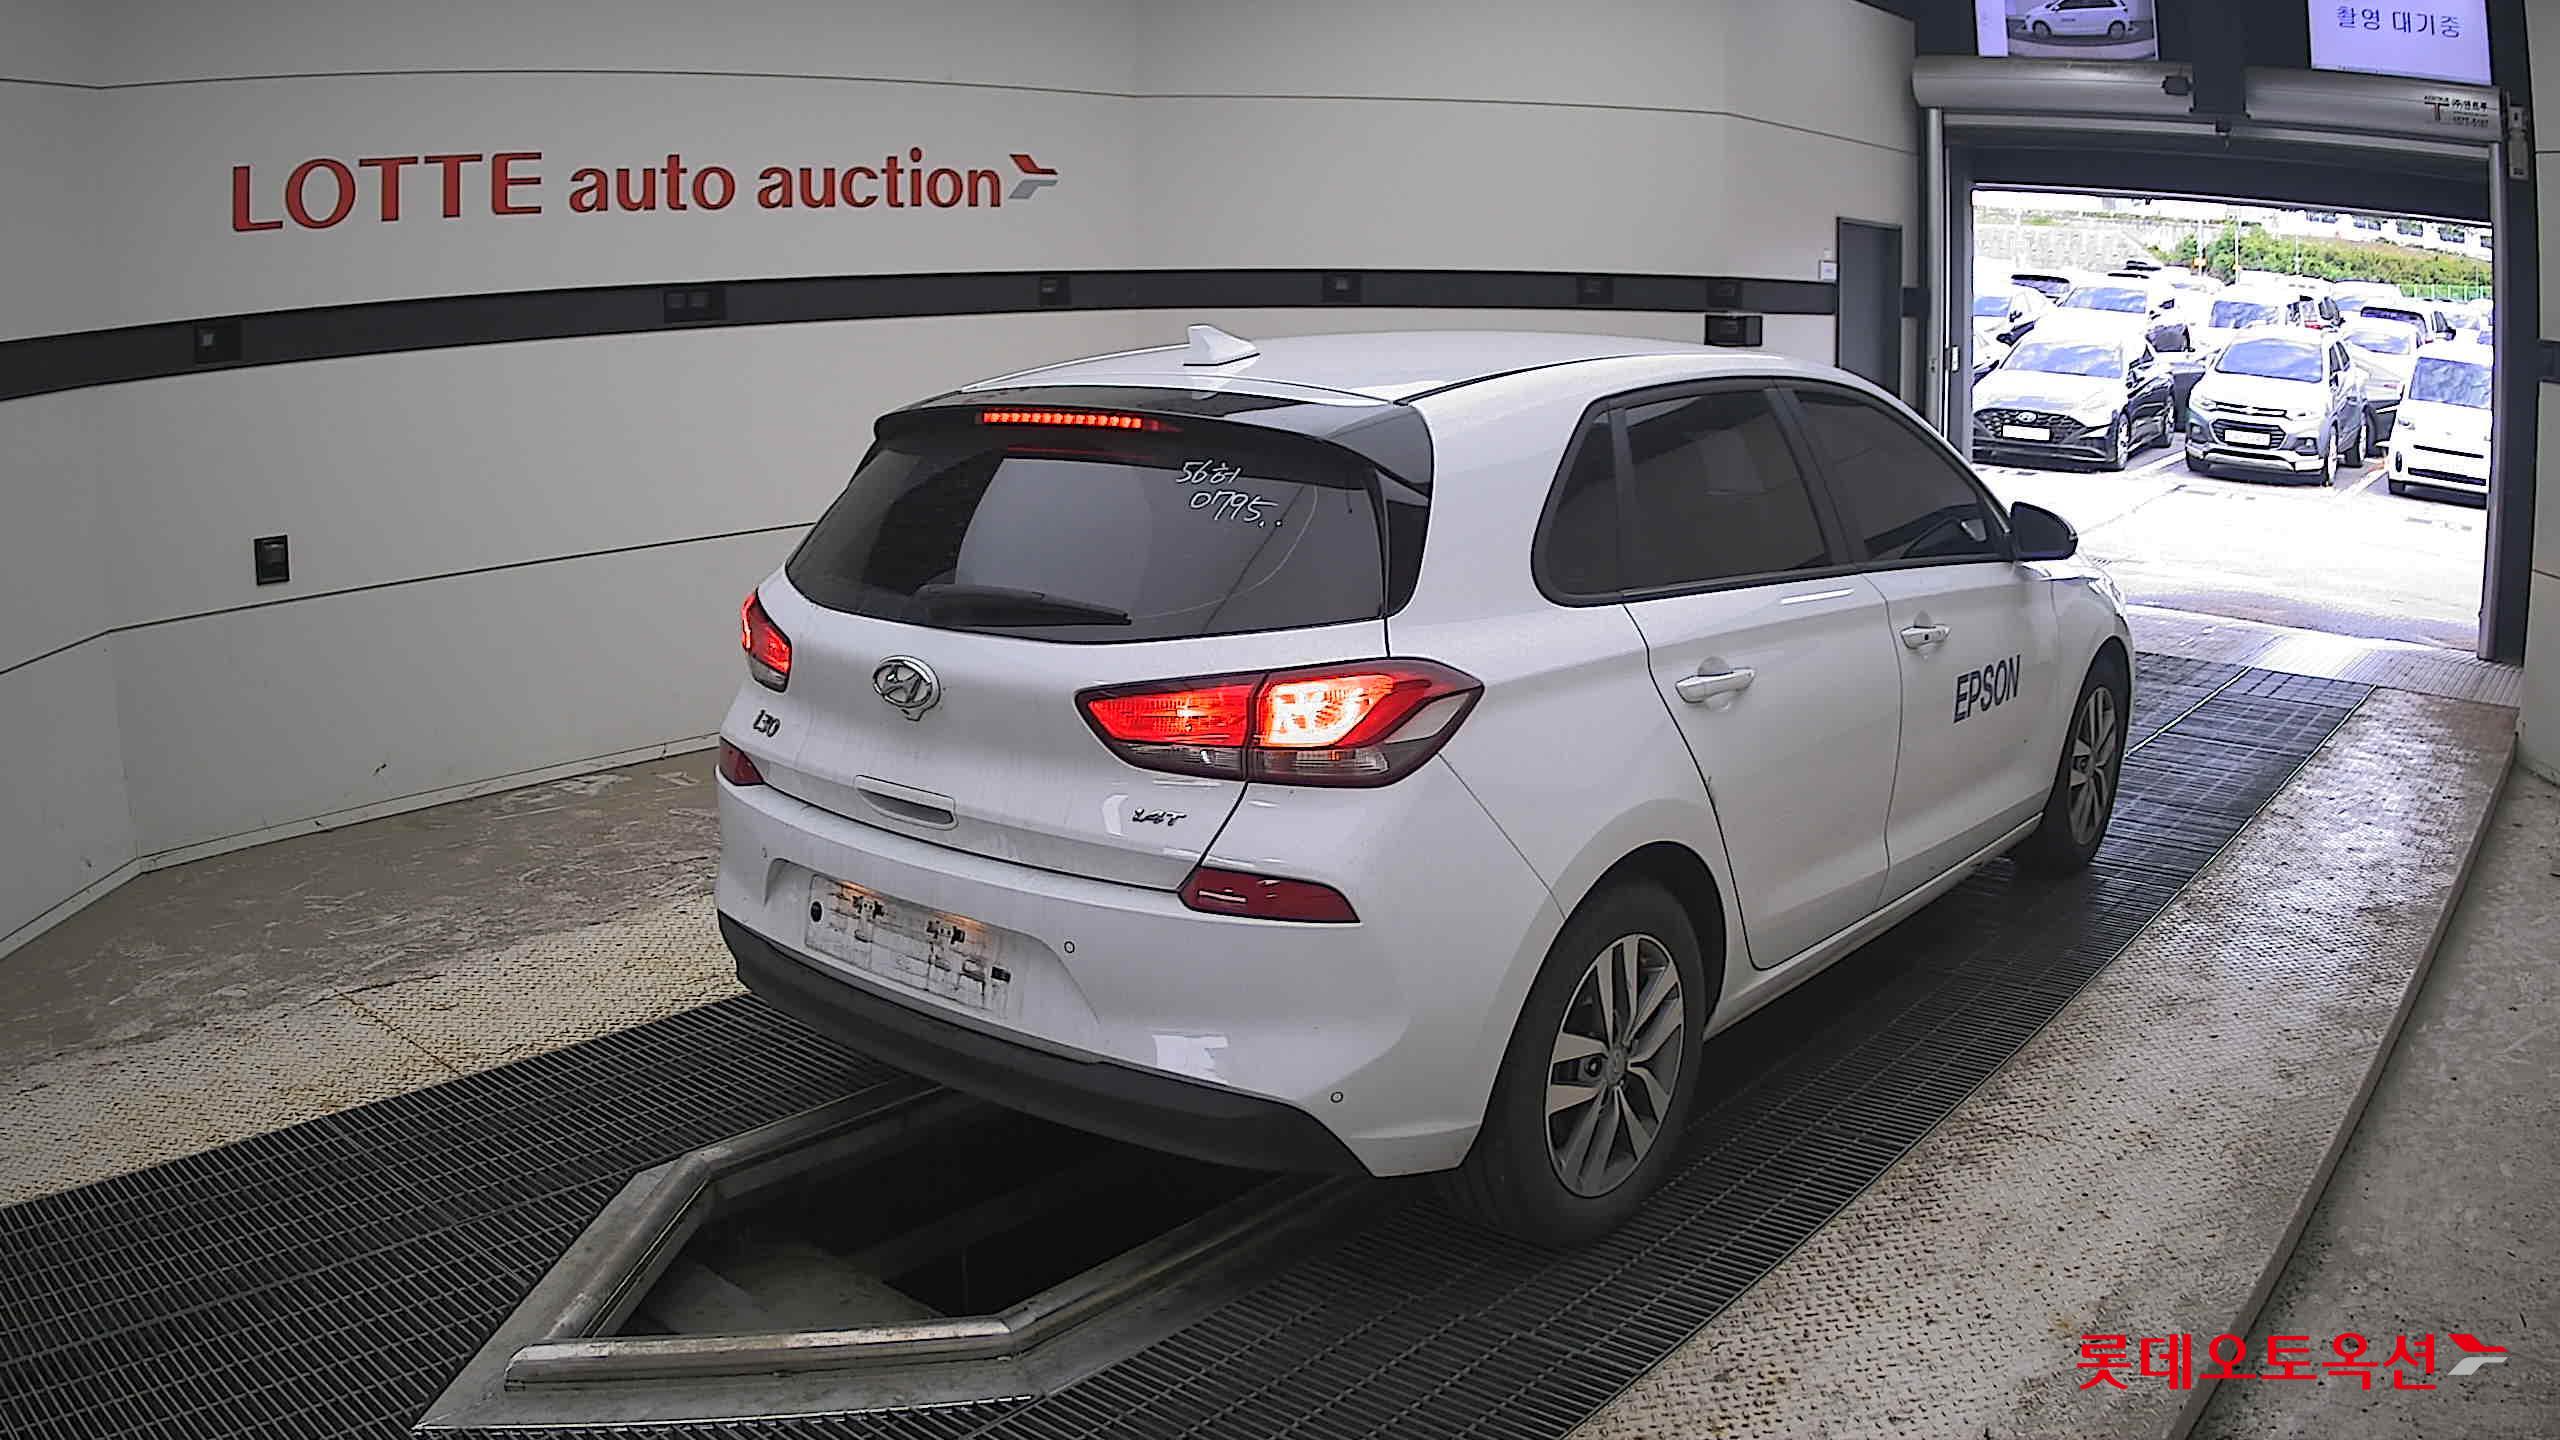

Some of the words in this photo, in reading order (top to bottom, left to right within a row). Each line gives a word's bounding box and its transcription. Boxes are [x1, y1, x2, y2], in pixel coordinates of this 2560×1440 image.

[2338, 6, 2381, 31] 촬영
[2392, 10, 2461, 39] 대기중
[232, 152, 542, 232] LOTTE
[568, 153, 736, 213] auto
[756, 147, 1002, 209] auction
[1953, 654, 2021, 724] EPSON
